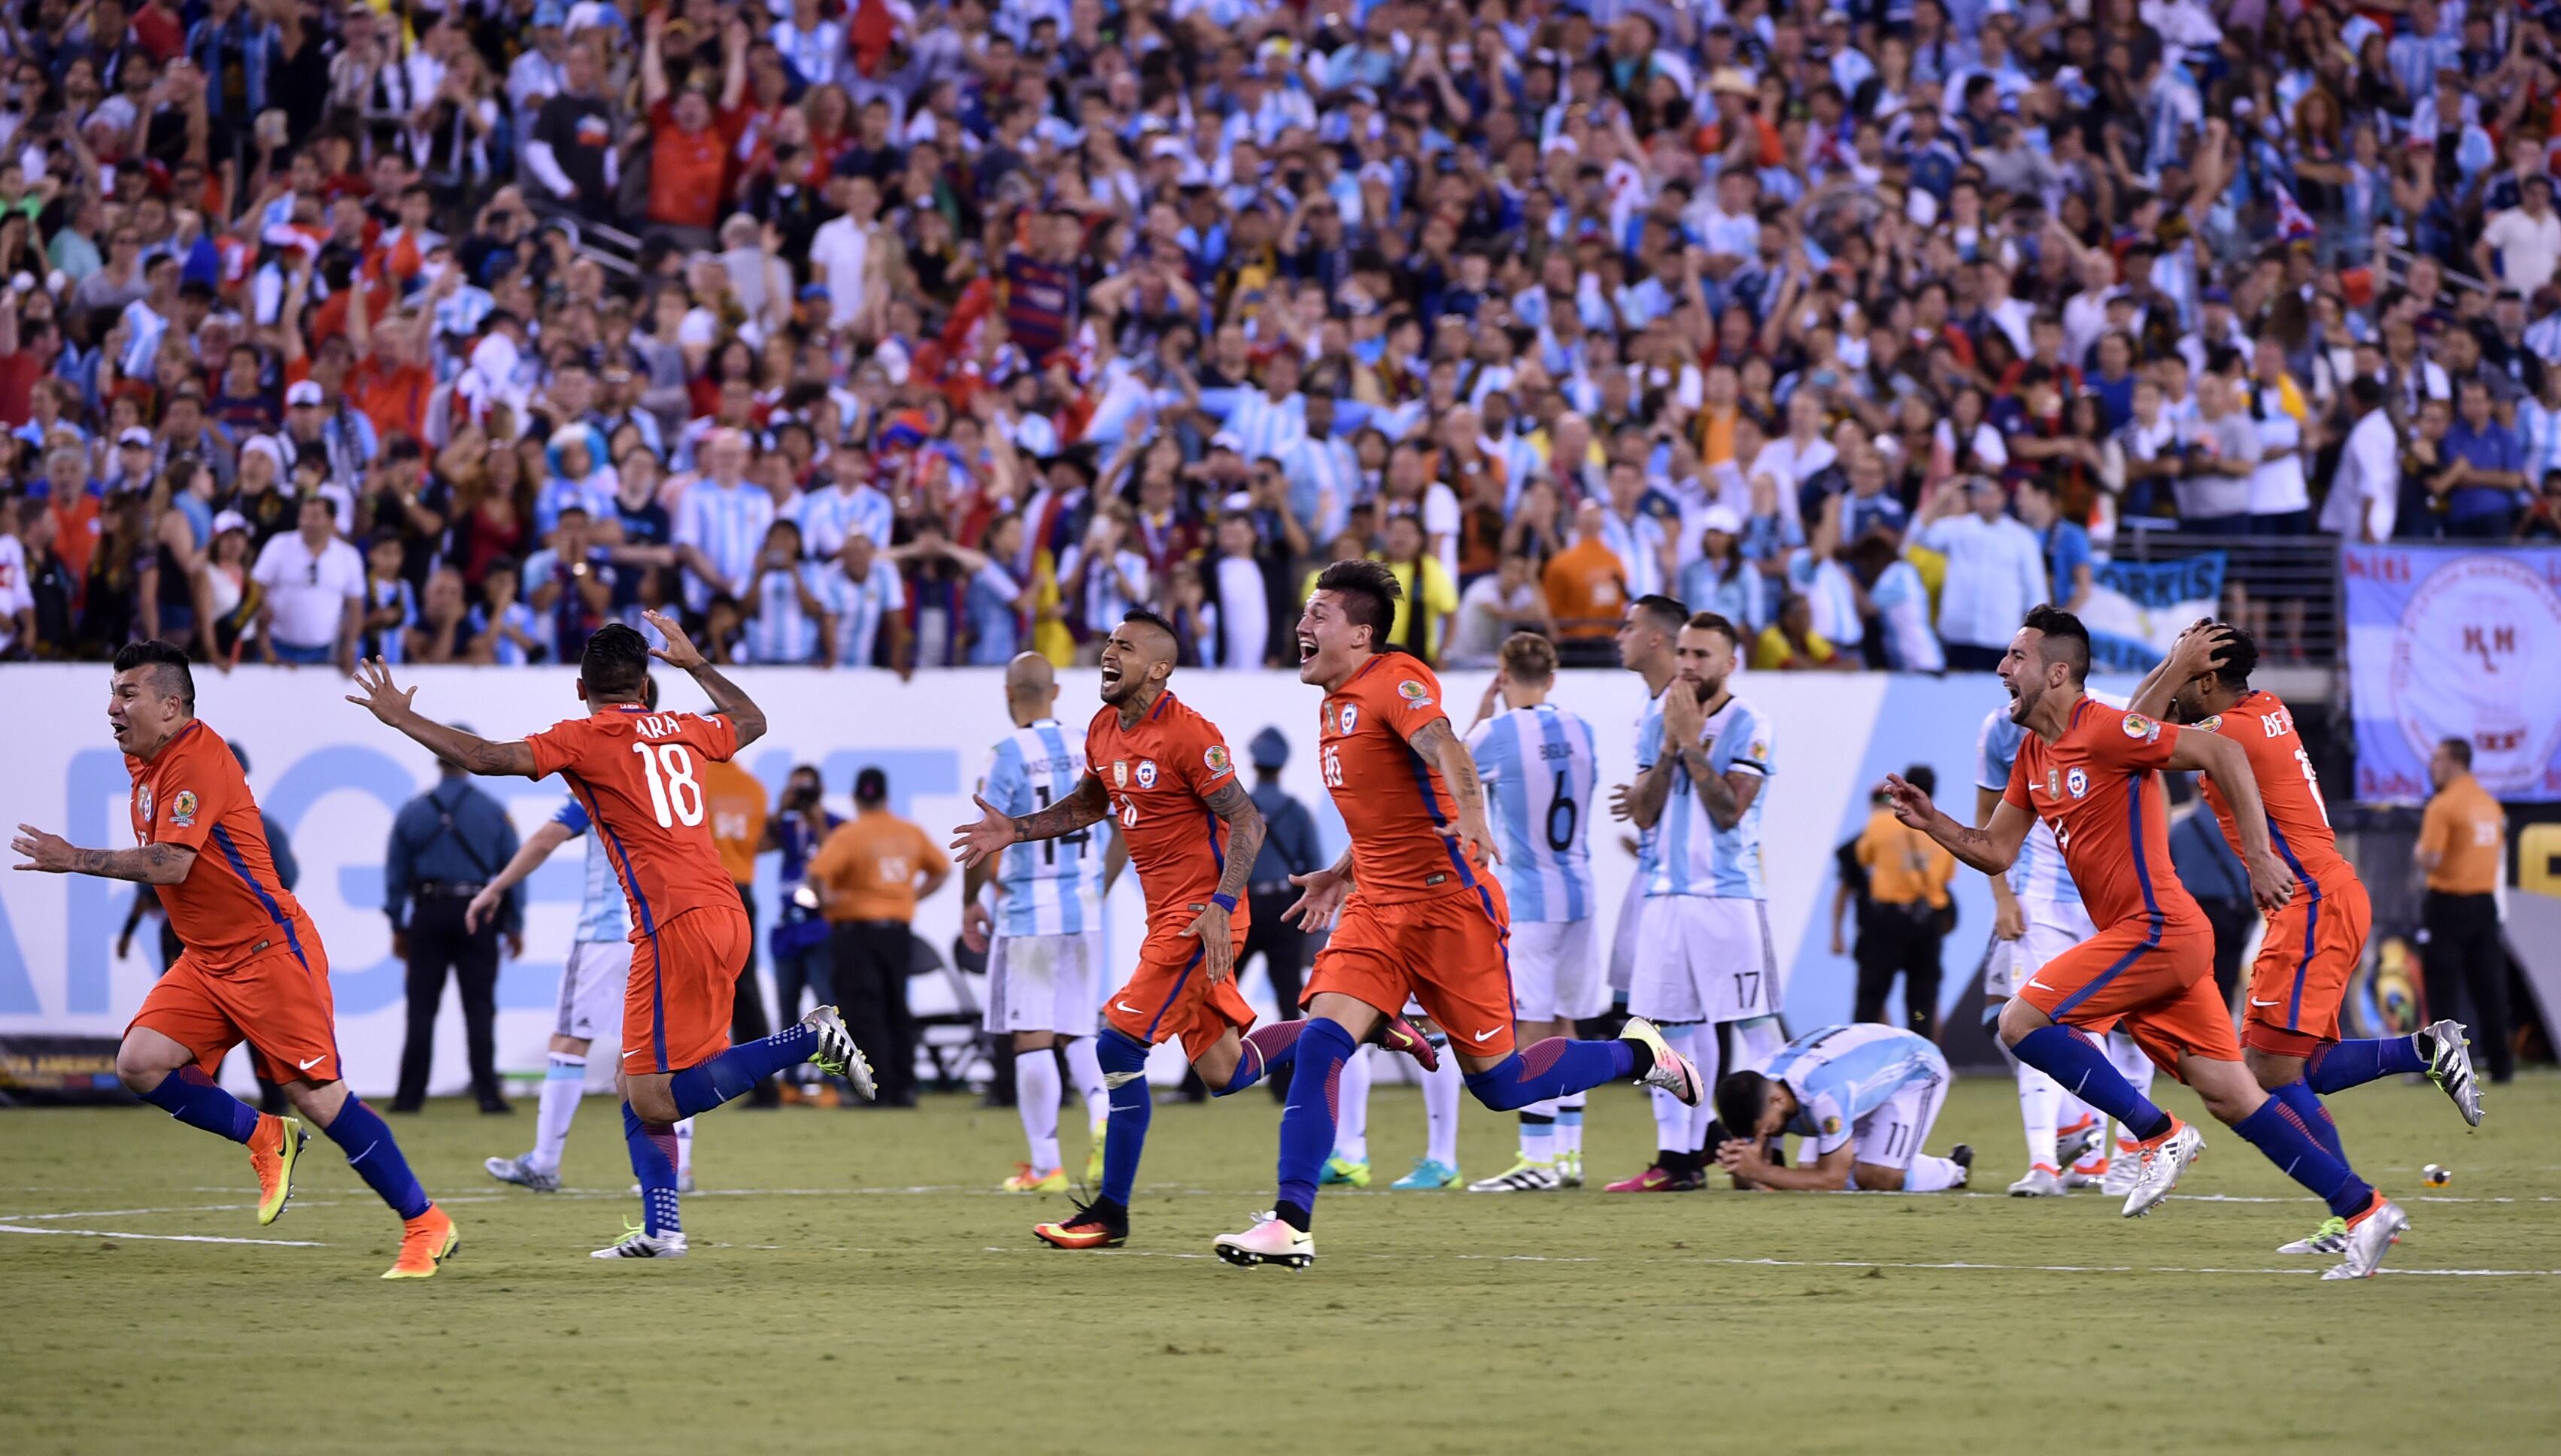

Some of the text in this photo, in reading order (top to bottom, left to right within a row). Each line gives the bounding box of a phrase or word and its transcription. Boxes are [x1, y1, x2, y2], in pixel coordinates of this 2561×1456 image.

[632, 742, 704, 828] 18
[1324, 745, 1344, 788] 16
[1120, 793, 1138, 829] 8
[1546, 770, 1577, 851] 6
[1733, 971, 1760, 1009] 17
[1884, 1121, 1909, 1159] 11
